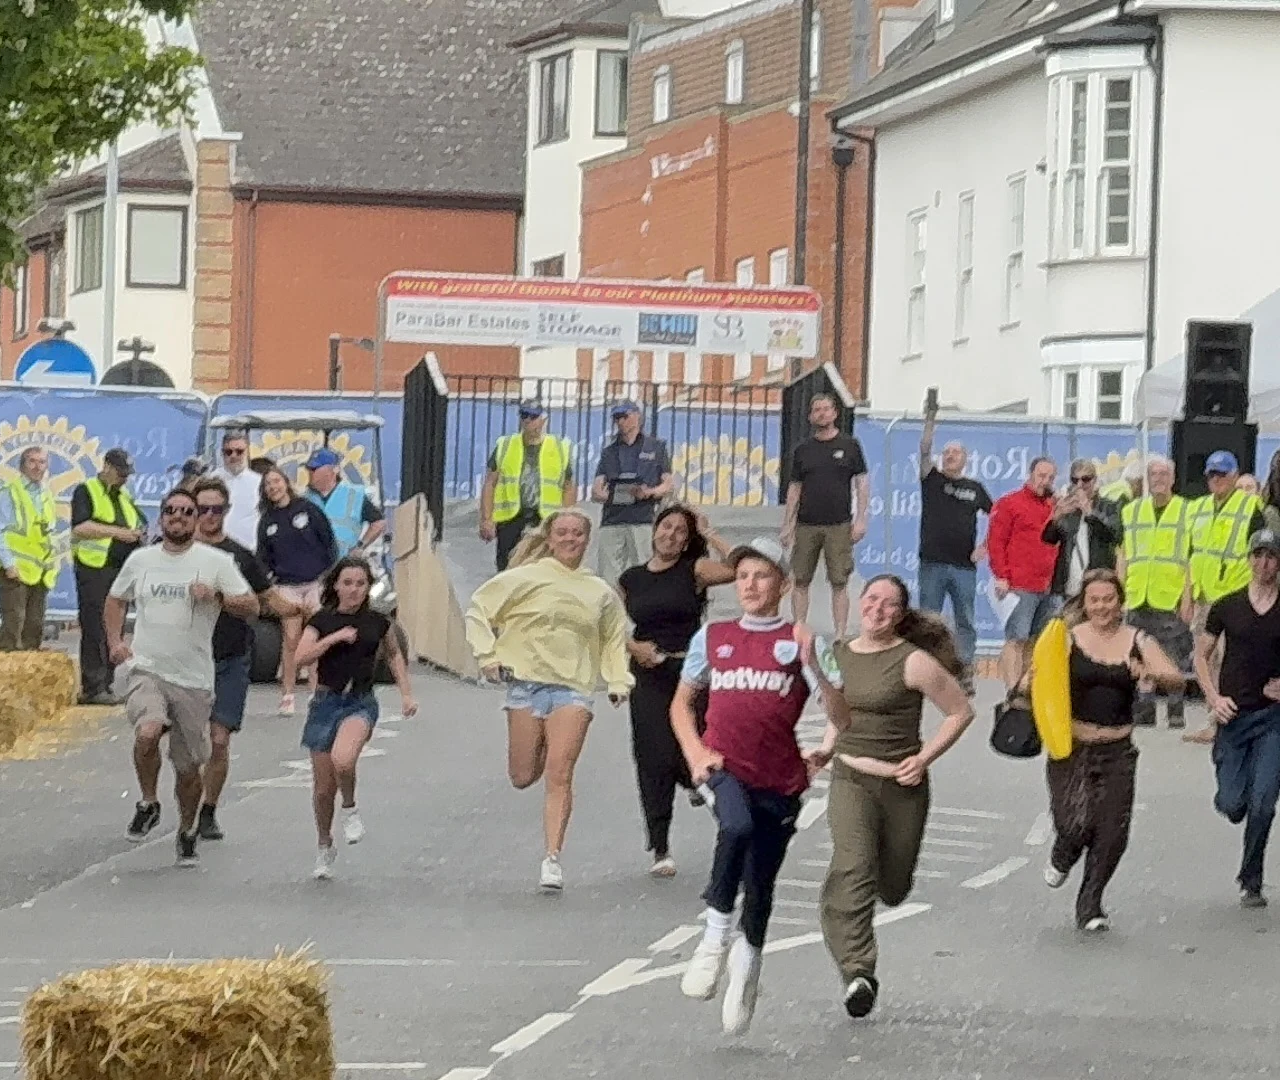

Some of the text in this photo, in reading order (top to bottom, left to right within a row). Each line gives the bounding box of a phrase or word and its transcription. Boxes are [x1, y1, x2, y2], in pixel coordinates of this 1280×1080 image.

[396, 280, 440, 293] With
[443, 282, 516, 295] grateful
[582, 287, 602, 298] to
[605, 288, 636, 300] our
[639, 288, 722, 303] Platinum
[395, 311, 531, 331] ParaBar Estates
[538, 323, 623, 338] STORAGE
[710, 667, 795, 699] betway
